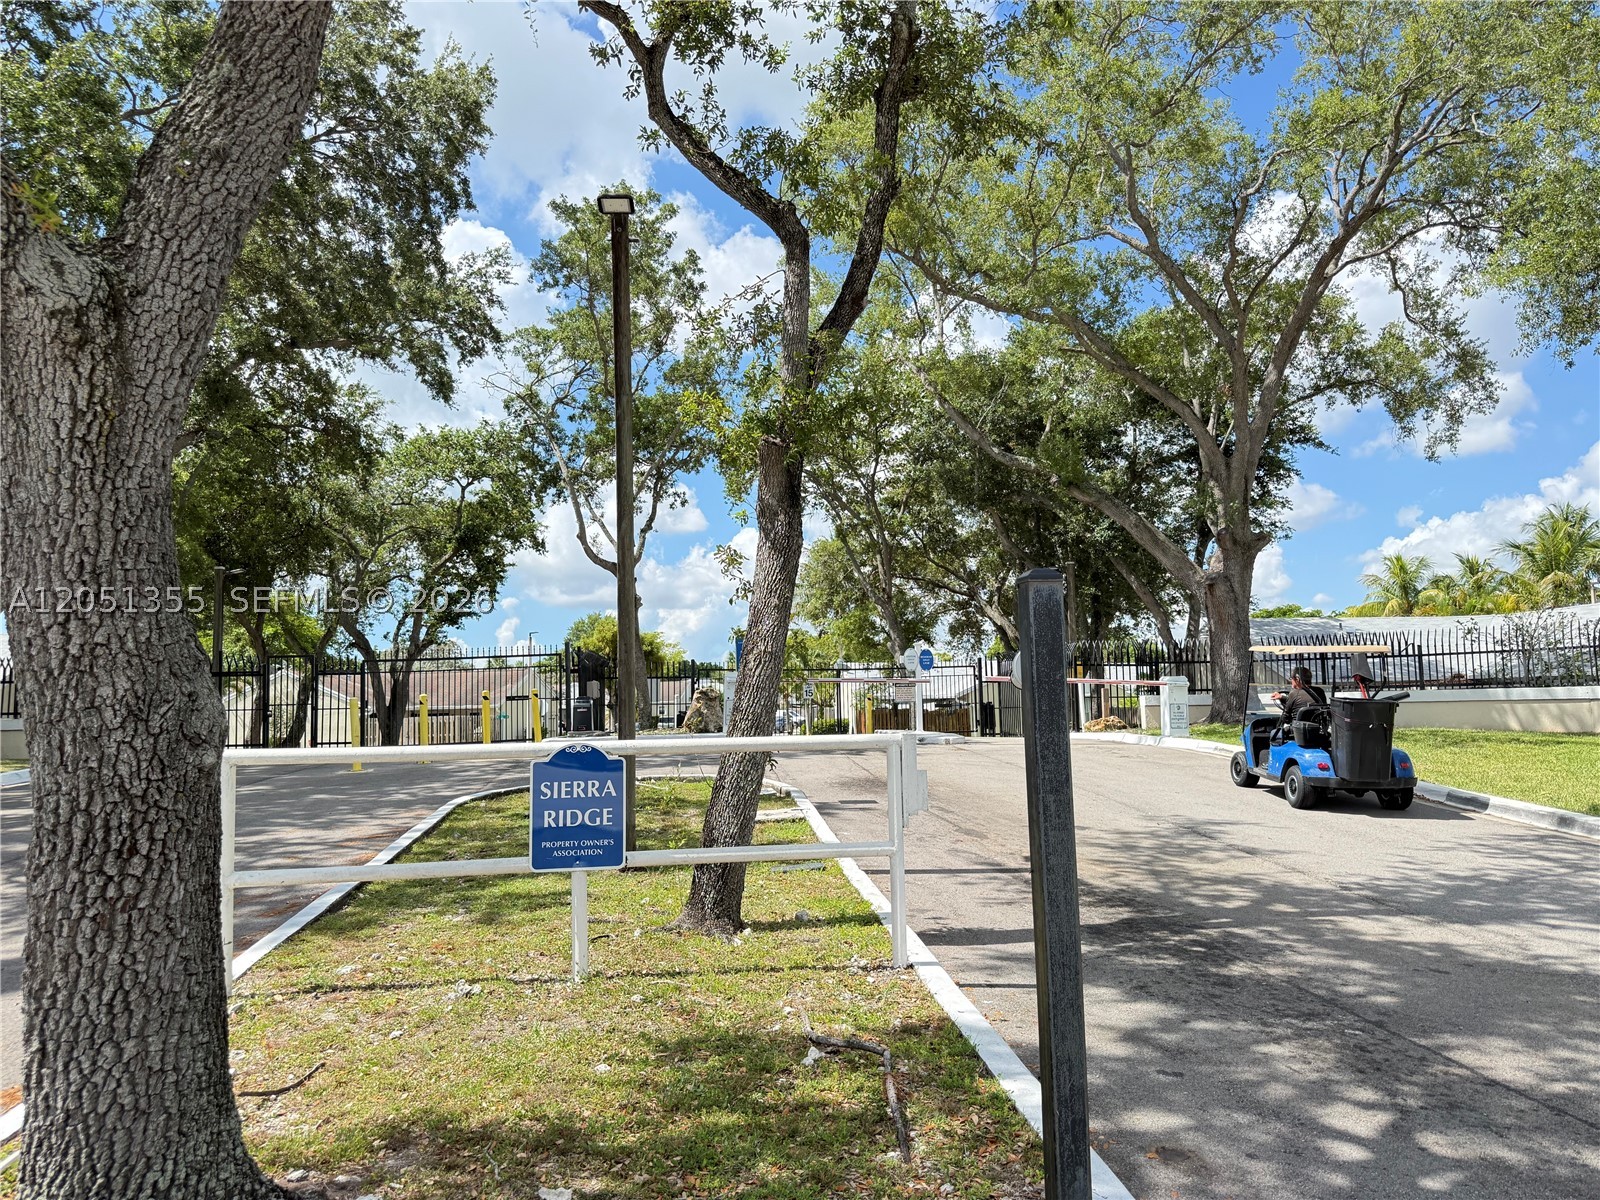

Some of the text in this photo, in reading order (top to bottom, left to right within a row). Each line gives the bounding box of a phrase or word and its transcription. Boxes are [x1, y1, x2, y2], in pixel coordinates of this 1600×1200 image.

[804, 689, 814, 698] 15
[540, 779, 617, 800] SIERRA
[543, 808, 613, 828] RIDGE
[541, 838, 615, 849] PROPERTY OWNER'S
[552, 848, 603, 857] ASSOCIATION
